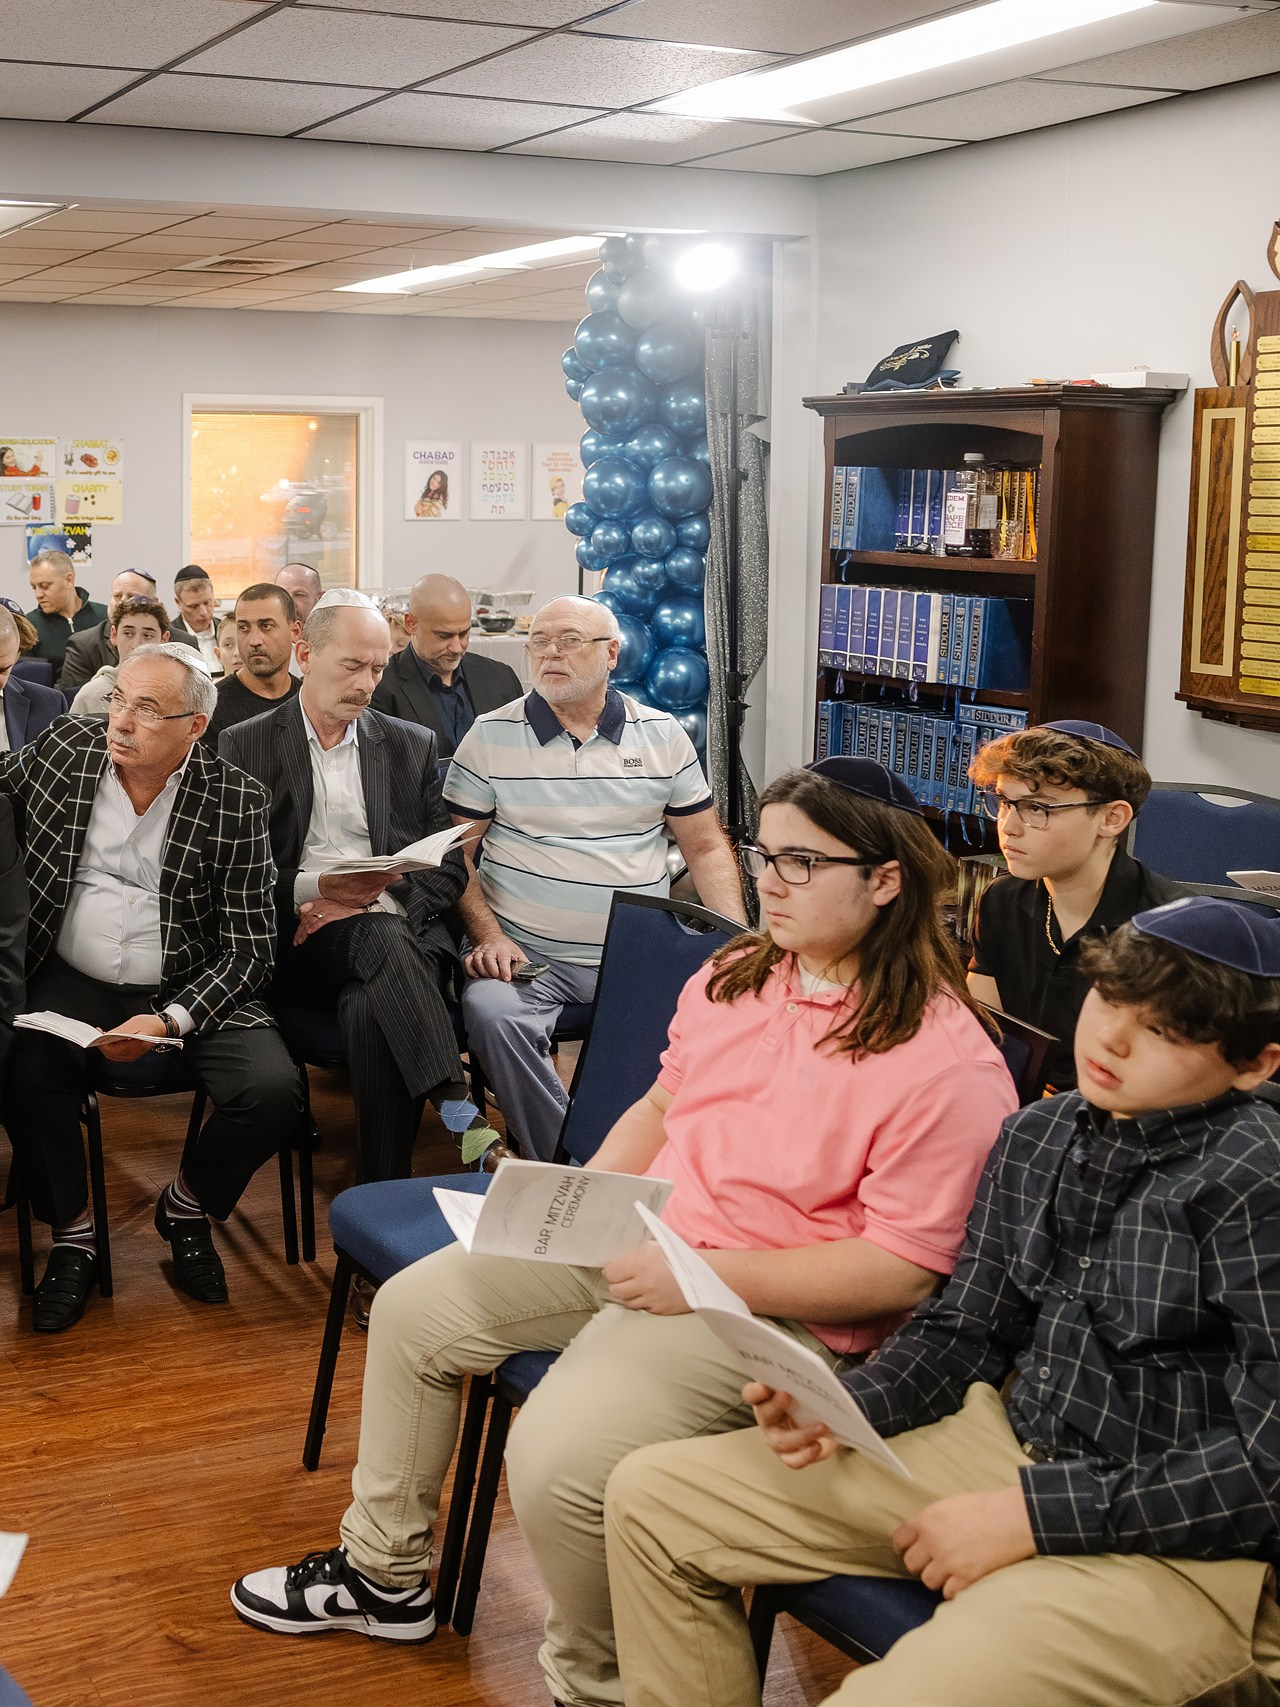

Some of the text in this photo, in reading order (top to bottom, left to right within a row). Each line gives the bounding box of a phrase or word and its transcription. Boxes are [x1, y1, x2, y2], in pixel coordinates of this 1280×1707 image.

[72, 440, 108, 448] SHABBAT
[413, 451, 454, 460] CHABAD
[72, 484, 108, 493] CHARITY
[833, 482, 843, 525] SIDDUR
[846, 484, 856, 526] SIDDUR
[48, 526, 87, 536] MITZVAH
[940, 612, 950, 656] SIDDUR
[953, 615, 964, 660] SIDDUR
[970, 615, 980, 661] SIDDUR
[843, 720, 852, 756] IDDUR
[976, 710, 1010, 724] SIDDUR
[896, 730, 905, 772] SIDDUR
[909, 734, 919, 775] SIDDUR
[922, 736, 931, 779] SIDDUR
[936, 738, 946, 781] SIDDUR
[960, 743, 970, 787] SIDDUR
[534, 1176, 576, 1254] BAR MITZVAH
[561, 1176, 591, 1228] CEREMONY
